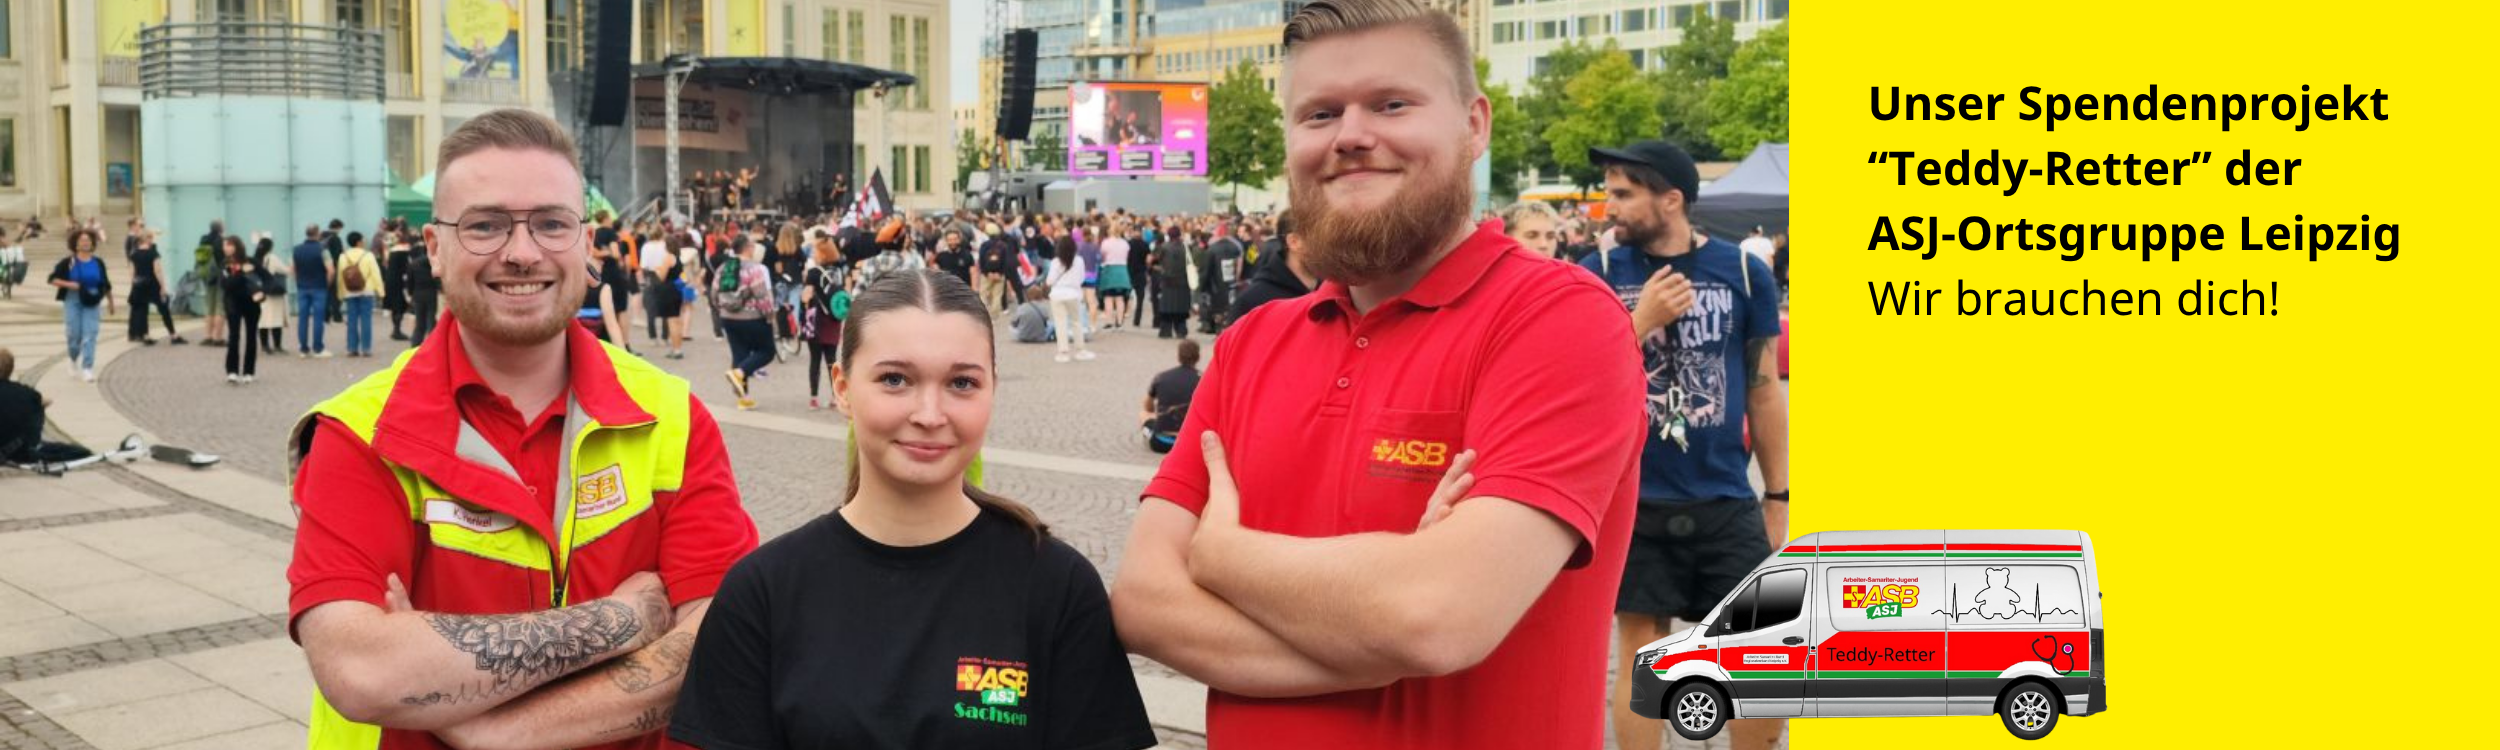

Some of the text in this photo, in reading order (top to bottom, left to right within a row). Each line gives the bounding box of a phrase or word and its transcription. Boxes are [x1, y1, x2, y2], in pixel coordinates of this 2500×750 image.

[1681, 288, 1733, 318] KINI
[1677, 306, 1722, 349] KILL
[1387, 440, 1446, 465] ASB
[1859, 584, 1920, 608] ASB
[1872, 604, 1898, 617] ASJ
[1826, 647, 1936, 666] Teddy-Retter
[975, 666, 1028, 697] ASB
[988, 690, 1016, 703] ASJ
[954, 702, 1027, 726] Sachsen
